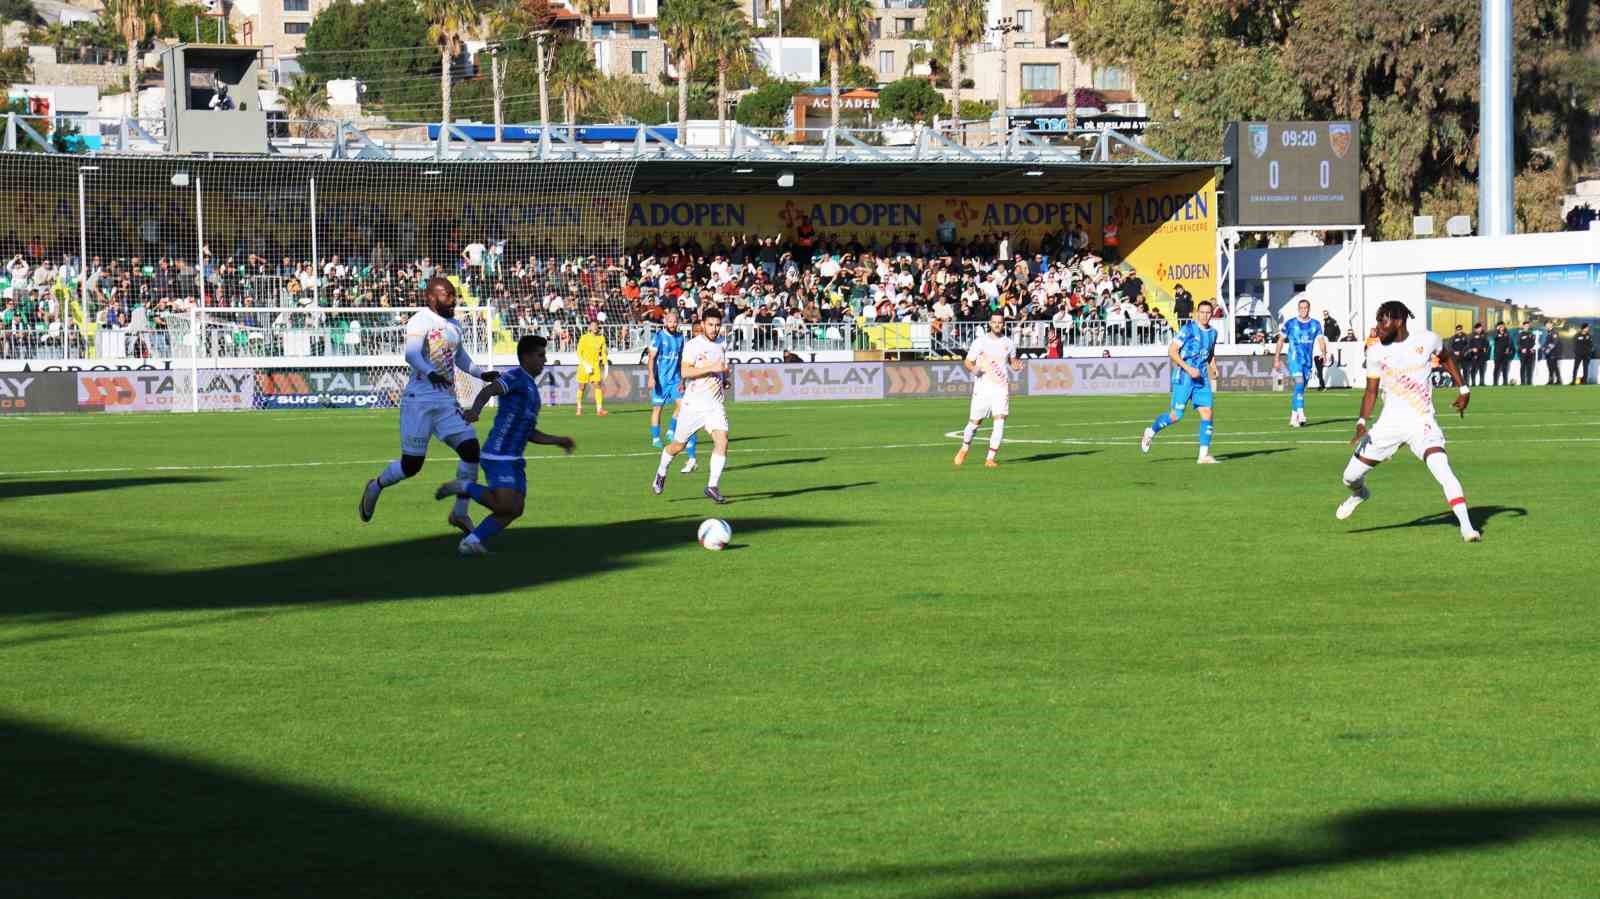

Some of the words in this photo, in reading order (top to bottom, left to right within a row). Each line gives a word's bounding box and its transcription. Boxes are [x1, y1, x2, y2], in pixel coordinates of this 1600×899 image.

[1282, 130, 1317, 146] 09:20
[1269, 160, 1279, 189] 0
[1319, 160, 1330, 189] 0
[627, 203, 746, 226] ADOPEN
[808, 203, 922, 225] ADOPEN
[983, 202, 1092, 225] ADOPEN
[1133, 192, 1208, 225] ADOPEN
[1167, 263, 1210, 280] ADOPEN
[784, 367, 880, 385] TALAY
[1076, 362, 1168, 380] TALAY
